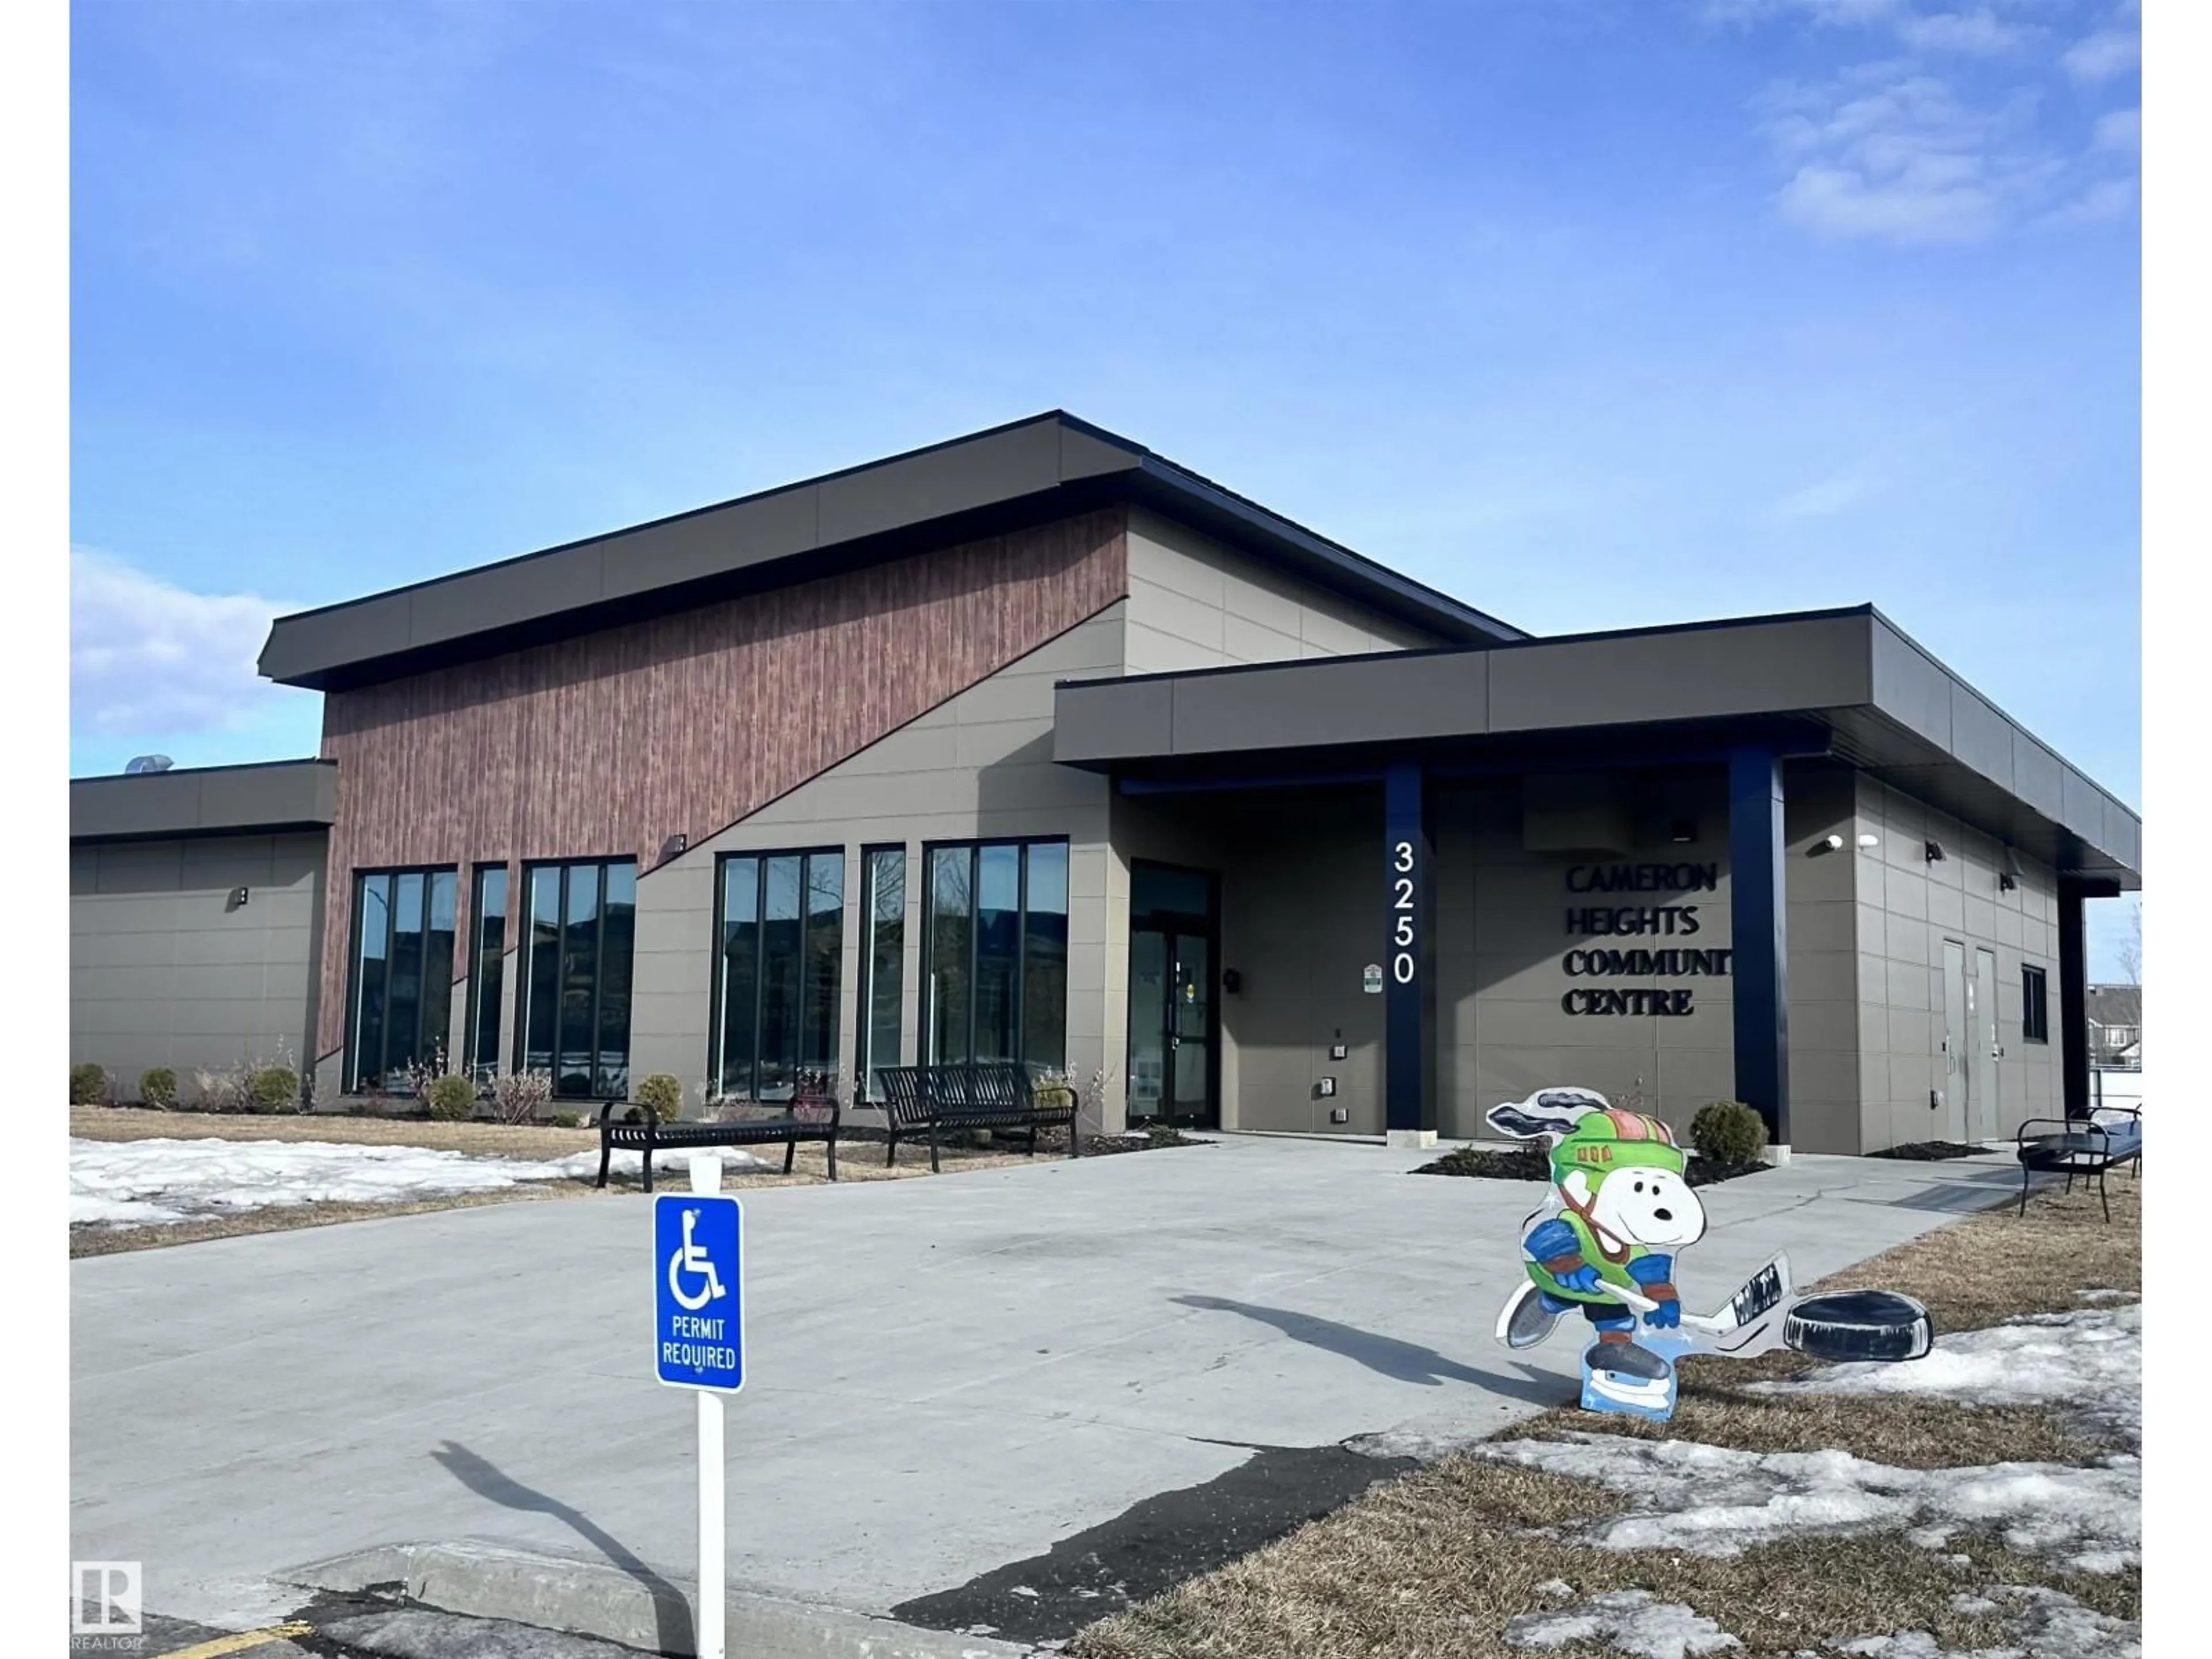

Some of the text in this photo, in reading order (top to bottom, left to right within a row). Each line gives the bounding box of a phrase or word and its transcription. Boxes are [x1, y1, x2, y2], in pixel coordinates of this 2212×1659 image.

[1566, 863, 1717, 892] CAMERON
[1394, 842, 1414, 984] 3250
[1565, 906, 1700, 935] HEIGHTS
[1561, 989, 1694, 1016] CENTRE
[673, 1316, 725, 1340] PERMIT
[664, 1342, 735, 1369] REQUIRED
